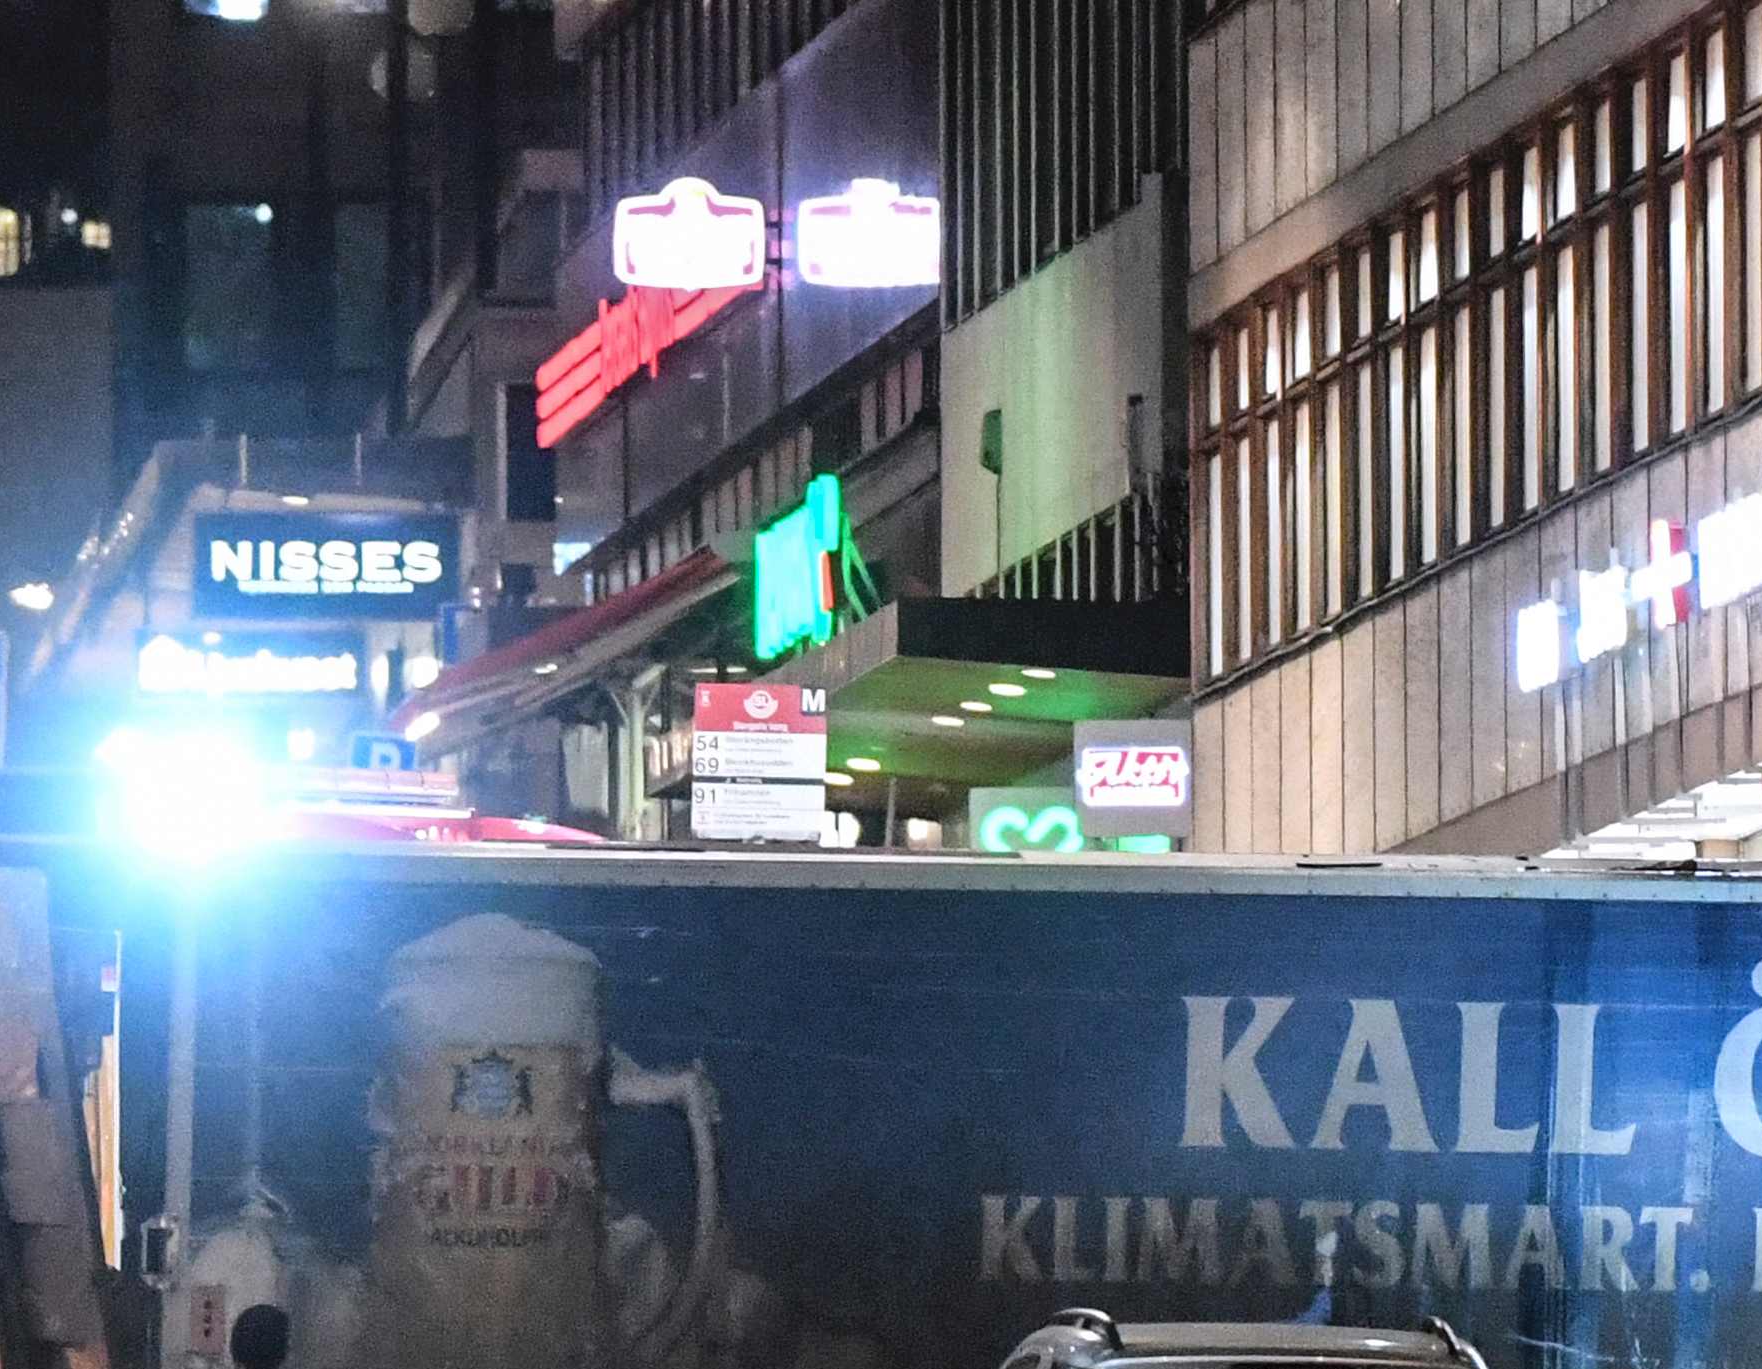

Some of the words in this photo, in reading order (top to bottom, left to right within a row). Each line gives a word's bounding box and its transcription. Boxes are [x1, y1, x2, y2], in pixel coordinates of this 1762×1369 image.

[210, 539, 444, 584] NISSES
[801, 688, 826, 713] M
[696, 735, 719, 752] 54
[695, 757, 720, 774] 69
[694, 788, 717, 804] 91
[1180, 995, 1634, 1156] KALL
[978, 1195, 1709, 1294] KLIMATSMART.
